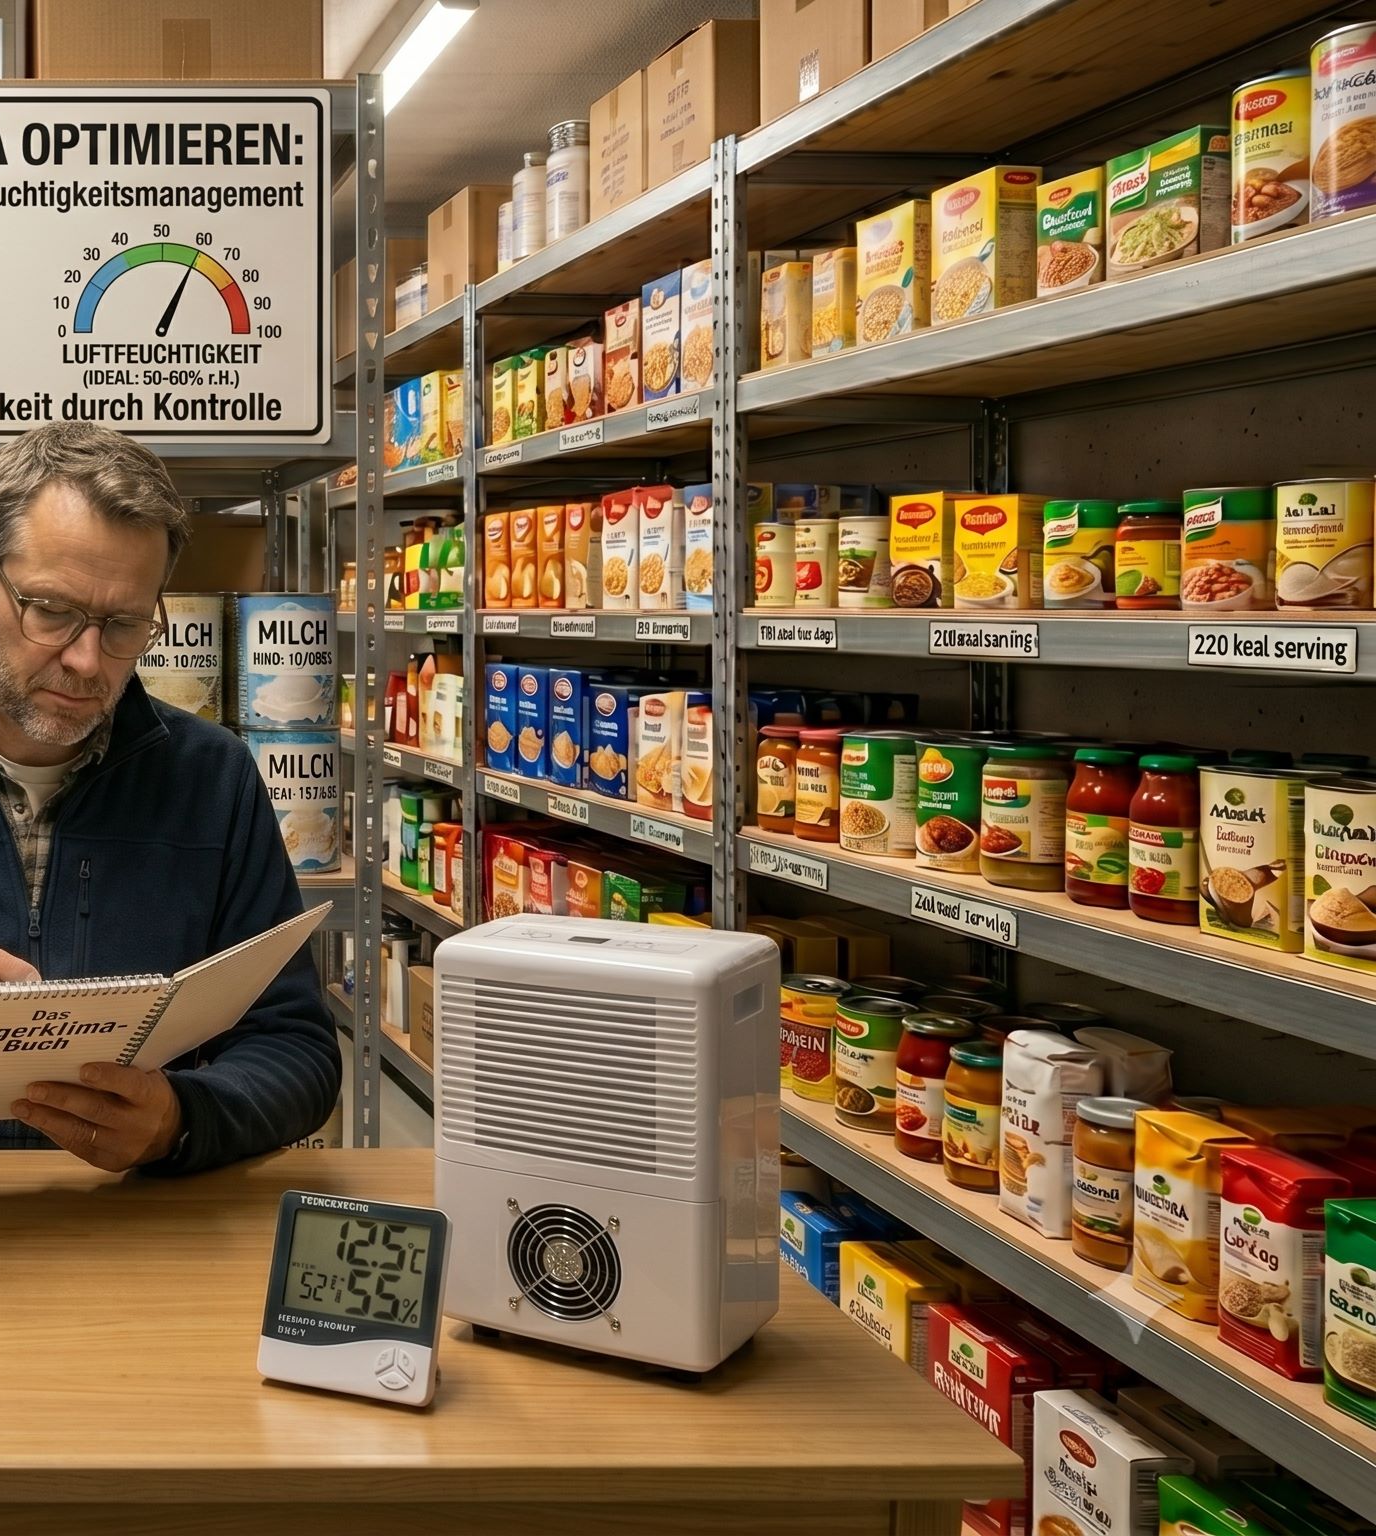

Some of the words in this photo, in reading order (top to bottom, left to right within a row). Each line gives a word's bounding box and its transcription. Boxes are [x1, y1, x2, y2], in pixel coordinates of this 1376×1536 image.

[22, 123, 304, 167] OPTIMIEREN:
[153, 224, 170, 238] 50
[112, 232, 128, 246] 40
[196, 232, 212, 246] 60
[84, 247, 100, 261] 30
[224, 247, 240, 261] 70
[64, 270, 81, 284] 20
[242, 270, 259, 283] 80
[54, 296, 70, 310] 10
[254, 297, 271, 310] 90
[58, 325, 66, 339] 0
[256, 325, 282, 339] 100
[62, 344, 262, 365] LUFTFEUCHTIGKEIT
[83, 370, 140, 388] (IDEAL:
[143, 370, 203, 386] 50-60%
[208, 370, 240, 388] r.H.)
[63, 392, 145, 422] durch
[154, 392, 282, 422] Kontrolle
[158, 623, 212, 647] ILCH
[259, 620, 327, 645] MILCH
[1195, 634, 1228, 656] 220
[1275, 637, 1347, 666] serving
[32, 1010, 70, 1020] Das
[2, 1038, 70, 1052] Buch
